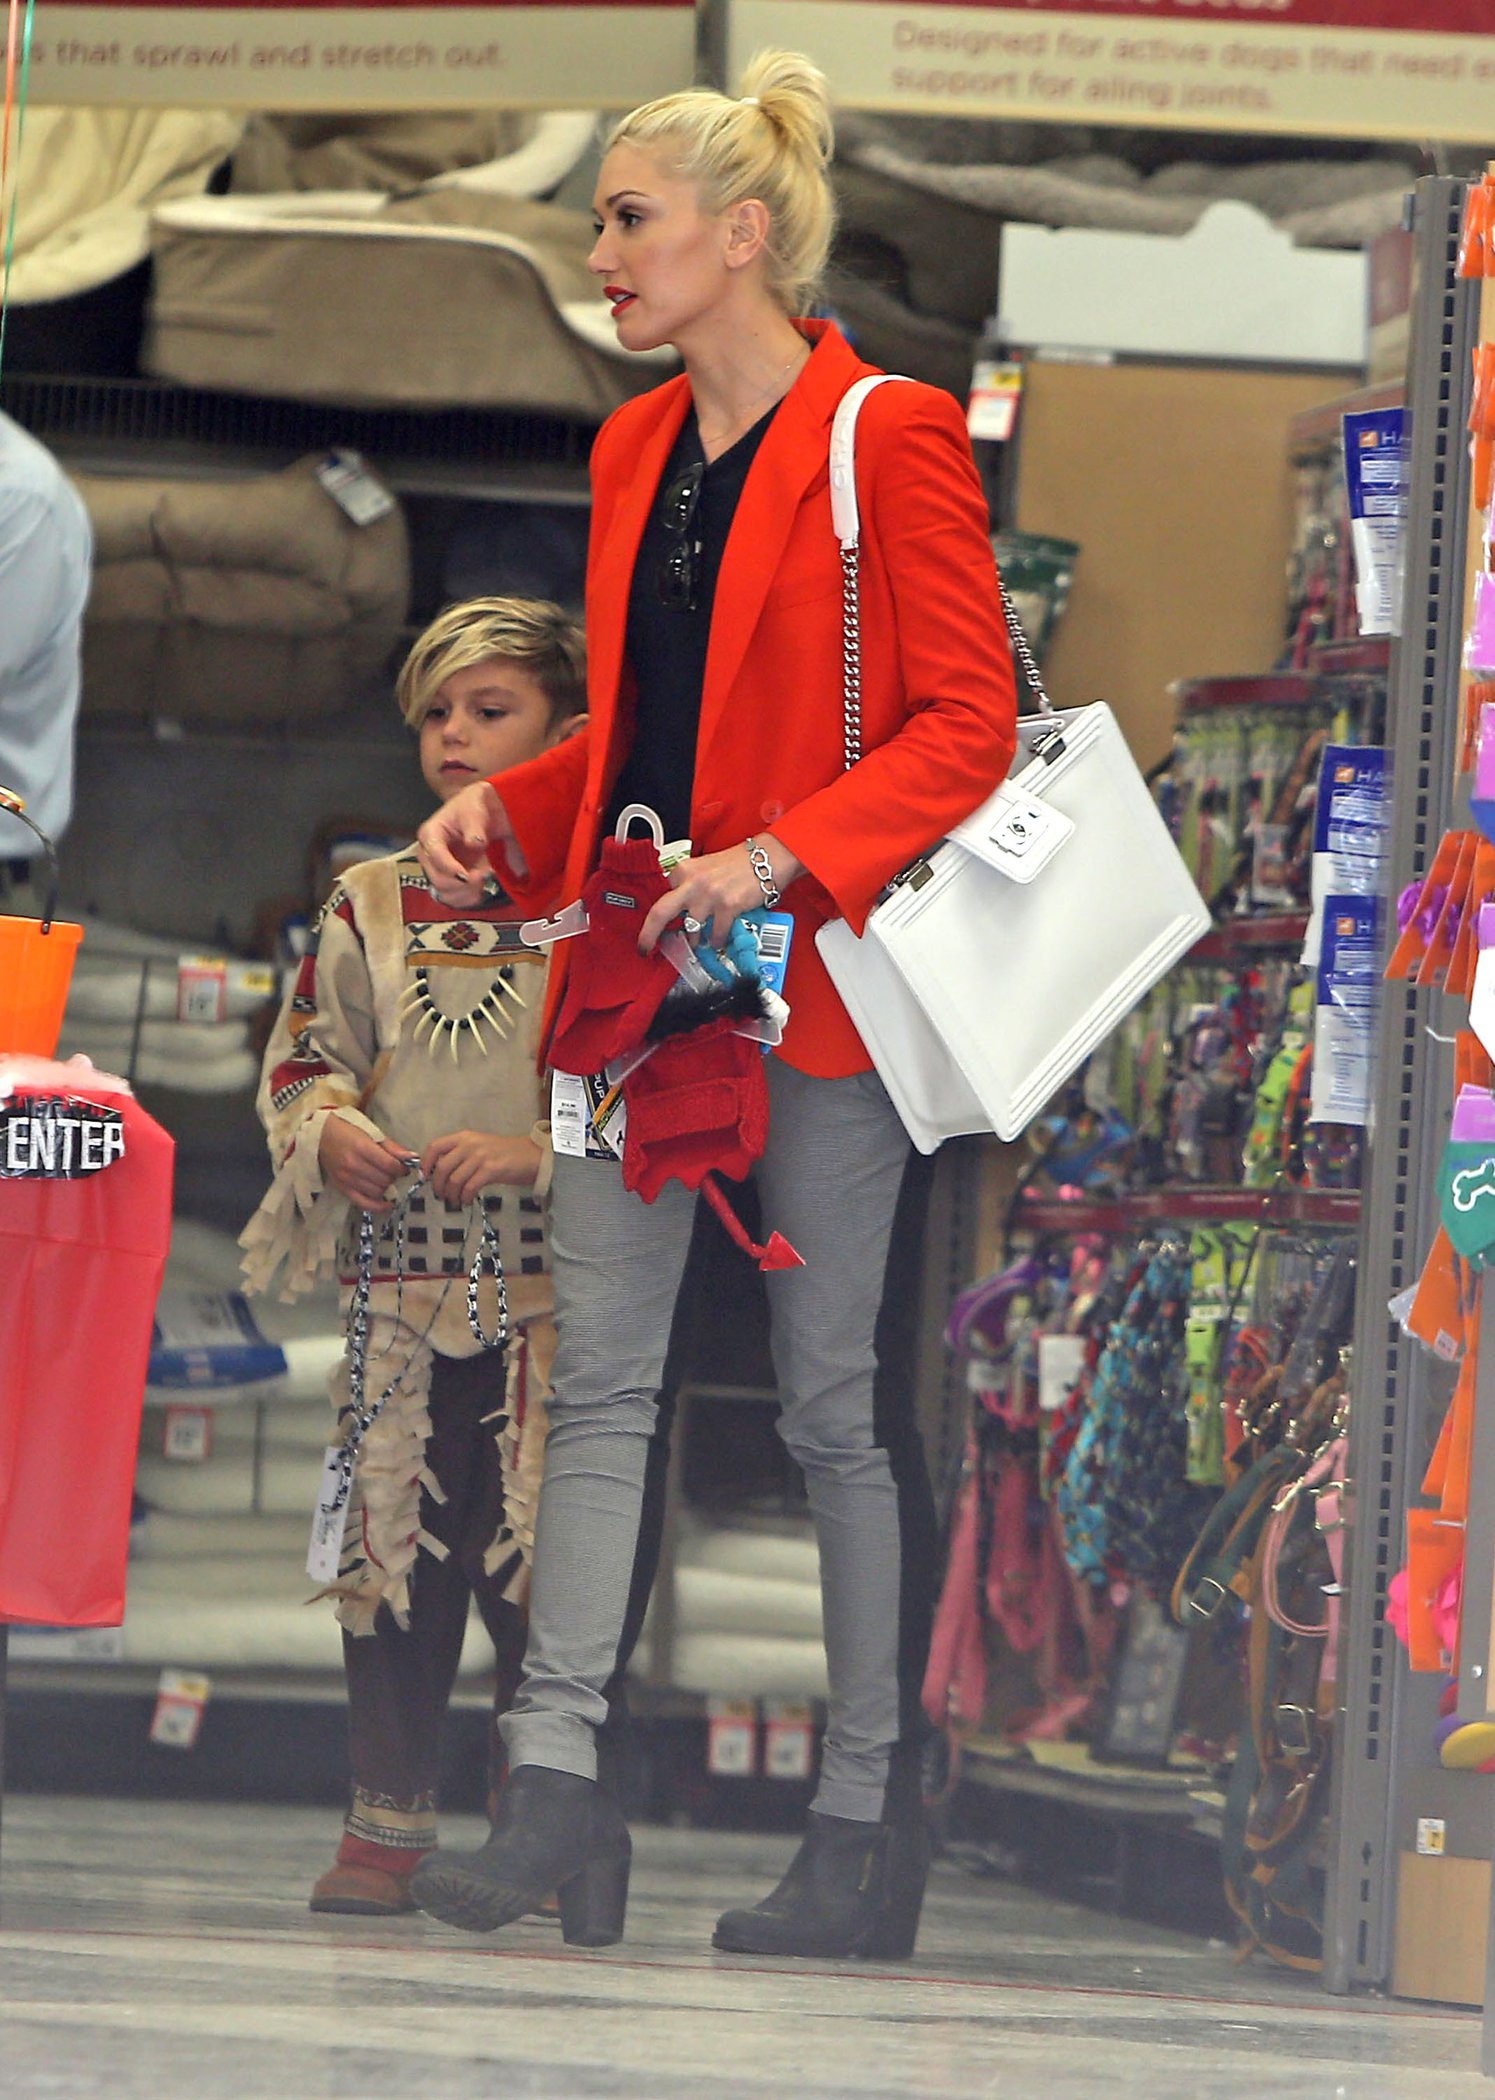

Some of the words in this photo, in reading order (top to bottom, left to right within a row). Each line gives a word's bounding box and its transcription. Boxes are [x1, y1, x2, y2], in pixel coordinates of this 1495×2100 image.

[57, 42, 120, 64] that
[135, 42, 239, 68] sprawl
[251, 43, 311, 66] and
[323, 42, 437, 67] stretch
[893, 21, 1048, 57] Designed
[1058, 30, 1103, 57] for
[1113, 36, 1210, 65] active
[1219, 43, 1300, 71] dogs
[1310, 46, 1374, 71] that
[1383, 52, 1466, 78] need
[892, 67, 1018, 96] support
[1028, 70, 1074, 97] for
[7, 1116, 125, 1169] ENTER
